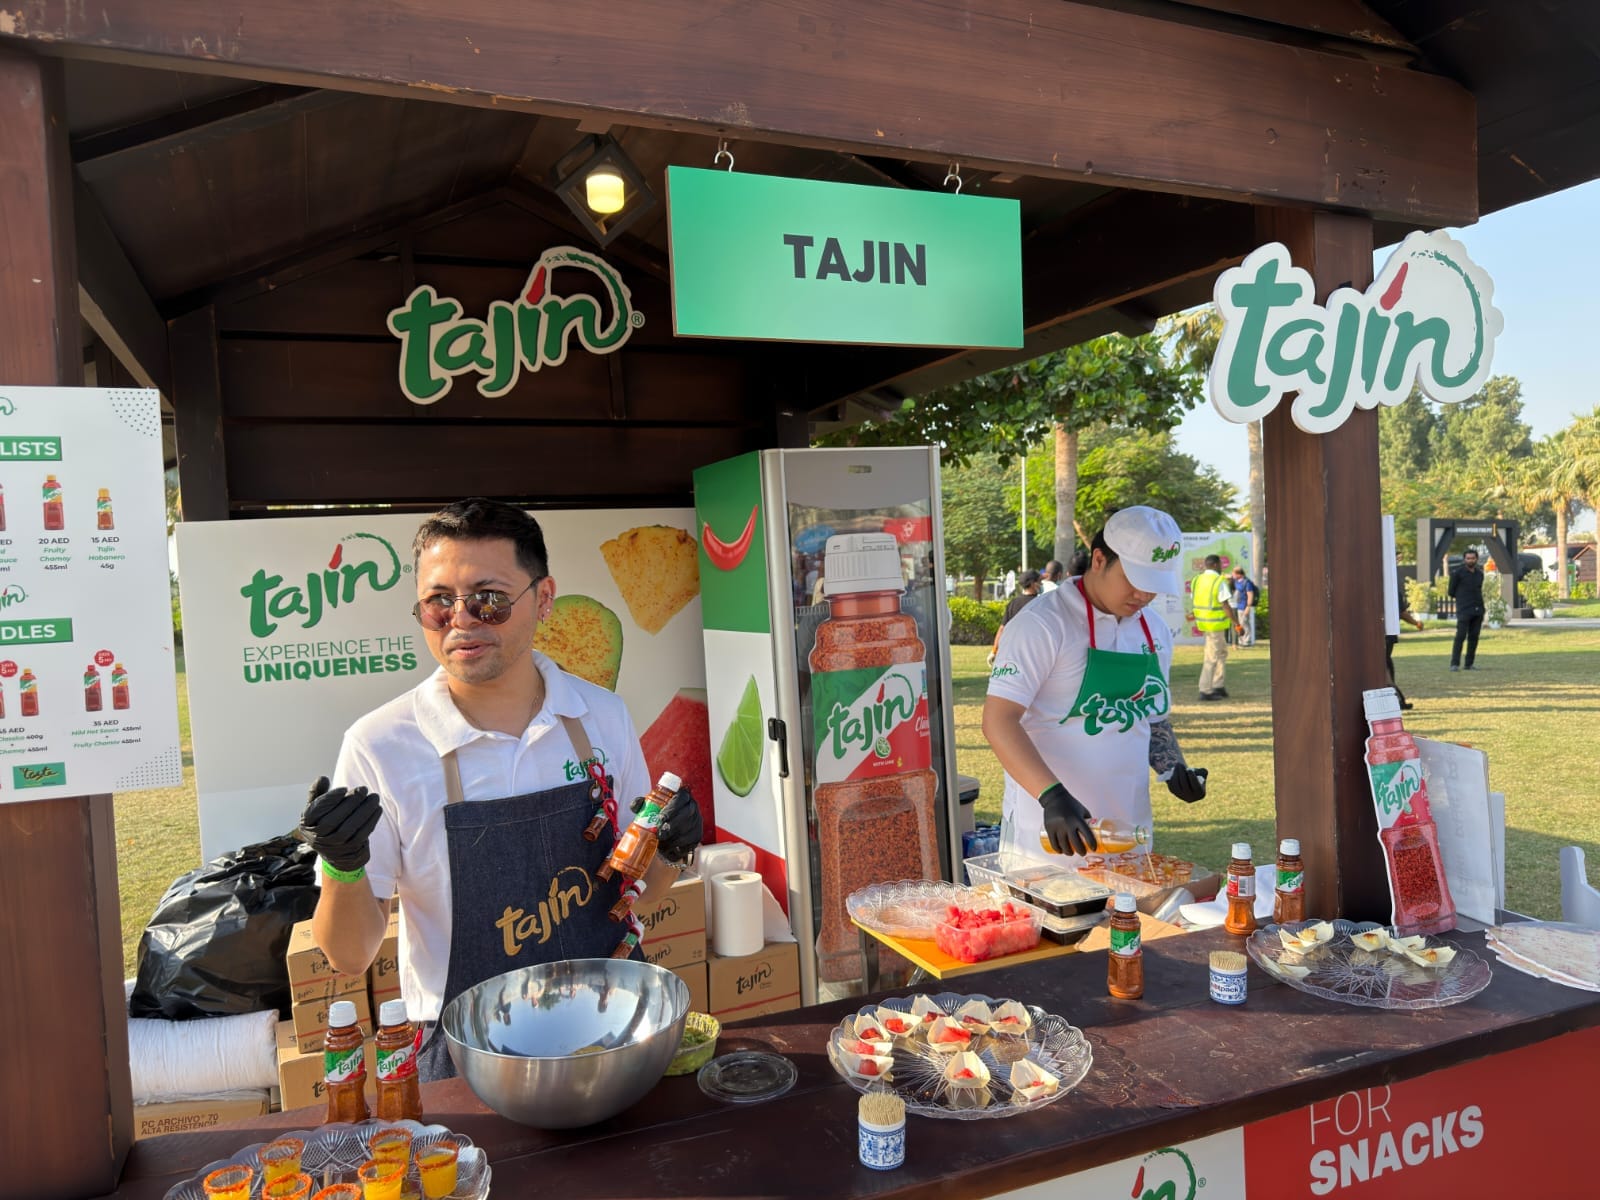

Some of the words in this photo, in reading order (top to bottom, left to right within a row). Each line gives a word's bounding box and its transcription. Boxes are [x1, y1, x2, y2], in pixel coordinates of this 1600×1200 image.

[783, 233, 927, 286] TAJIN
[0, 441, 57, 456] LISTS
[243, 639, 371, 663] EXPERIENCE
[376, 636, 414, 652] THE
[243, 652, 417, 683] UNIQUENESS
[141, 1120, 155, 1129] PC
[157, 1114, 201, 1127] ARCHIVO
[207, 1112, 219, 1120] 70
[1310, 1084, 1391, 1144] FOR
[141, 1127, 162, 1135] ALTA
[1310, 1105, 1484, 1195] SNACKS
